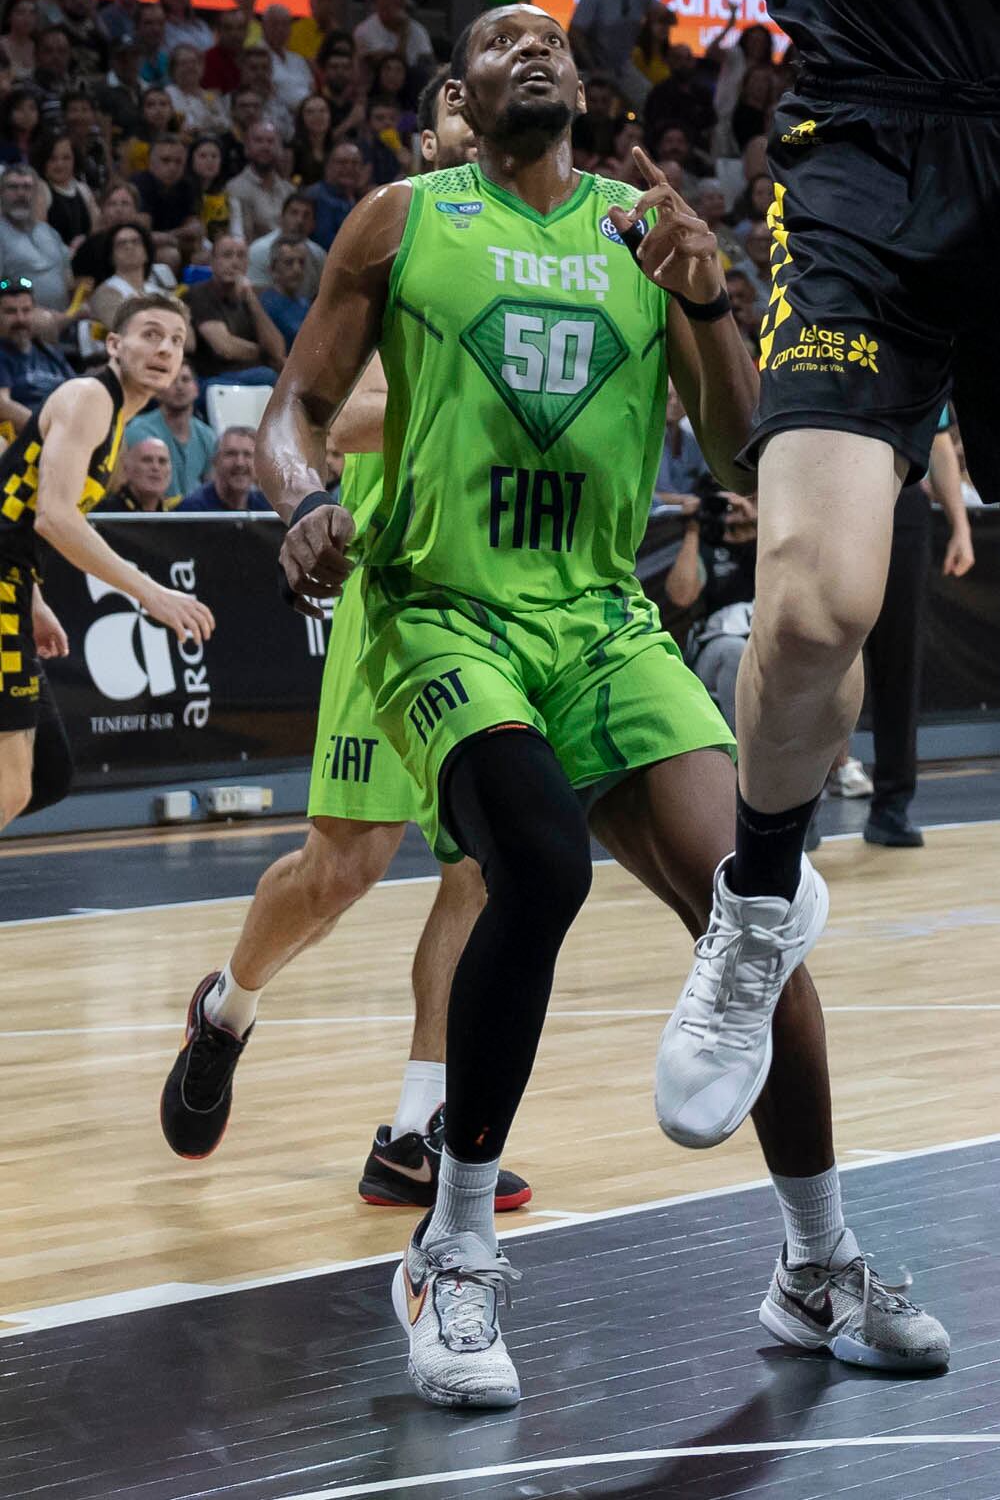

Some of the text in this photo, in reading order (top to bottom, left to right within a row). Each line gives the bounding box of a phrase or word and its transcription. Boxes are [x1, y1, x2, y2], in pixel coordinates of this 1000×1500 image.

[487, 245, 610, 302] TOFAŞ
[501, 312, 596, 395] 50
[800, 324, 846, 345] Islas
[489, 465, 588, 553] FIAT
[90, 712, 174, 734] TENERIFE SUR
[408, 667, 470, 747] FIAT
